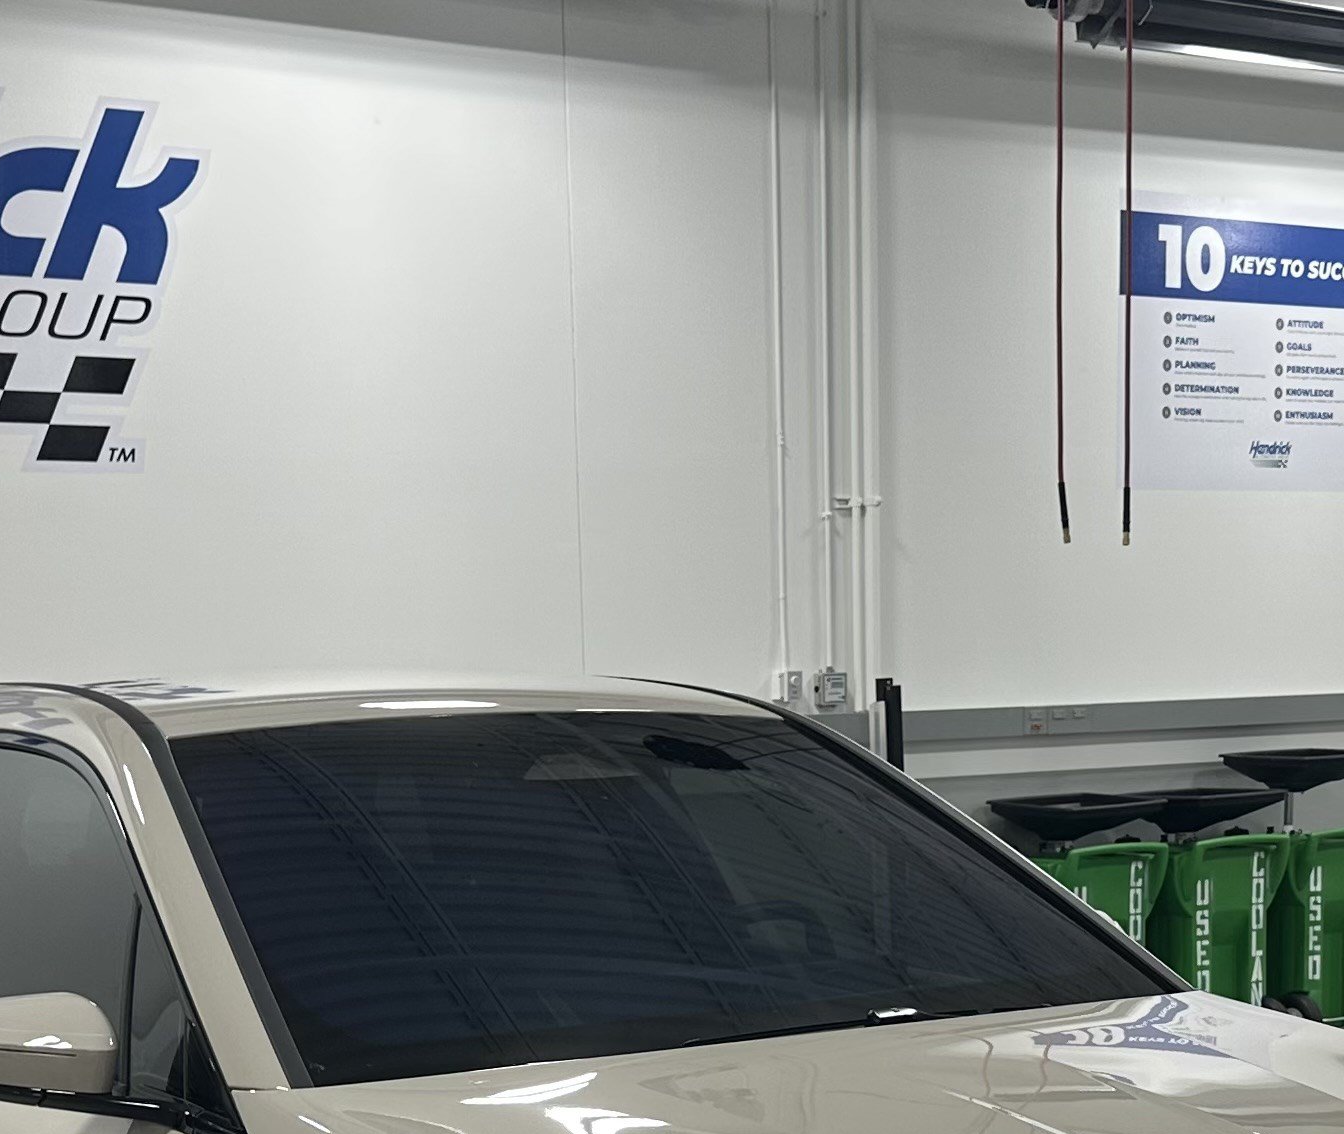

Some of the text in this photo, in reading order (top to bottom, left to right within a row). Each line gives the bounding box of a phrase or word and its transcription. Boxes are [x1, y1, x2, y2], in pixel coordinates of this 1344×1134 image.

[1157, 223, 1227, 292] 10
[1230, 255, 1277, 276] KEYS
[1280, 258, 1305, 278] TO
[1175, 312, 1215, 323] OPTIMISM
[1287, 320, 1324, 330] ATTITUDE
[1175, 336, 1199, 346] FAITH
[1286, 342, 1312, 352] GOALS
[1174, 360, 1216, 371] PLANNING
[1286, 365, 1344, 376] PERSEVERANCE
[1174, 383, 1240, 395] DETERMINATION
[1285, 388, 1334, 398] KNOWLEDGE
[1174, 406, 1202, 416] VISION
[1285, 410, 1333, 420] ENTHUSIASM
[108, 447, 136, 463] TM
[1248, 440, 1293, 459] Hendrick
[1308, 865, 1322, 980] USED
[1251, 851, 1265, 1007] COOLAN
[1196, 879, 1210, 993] USED
